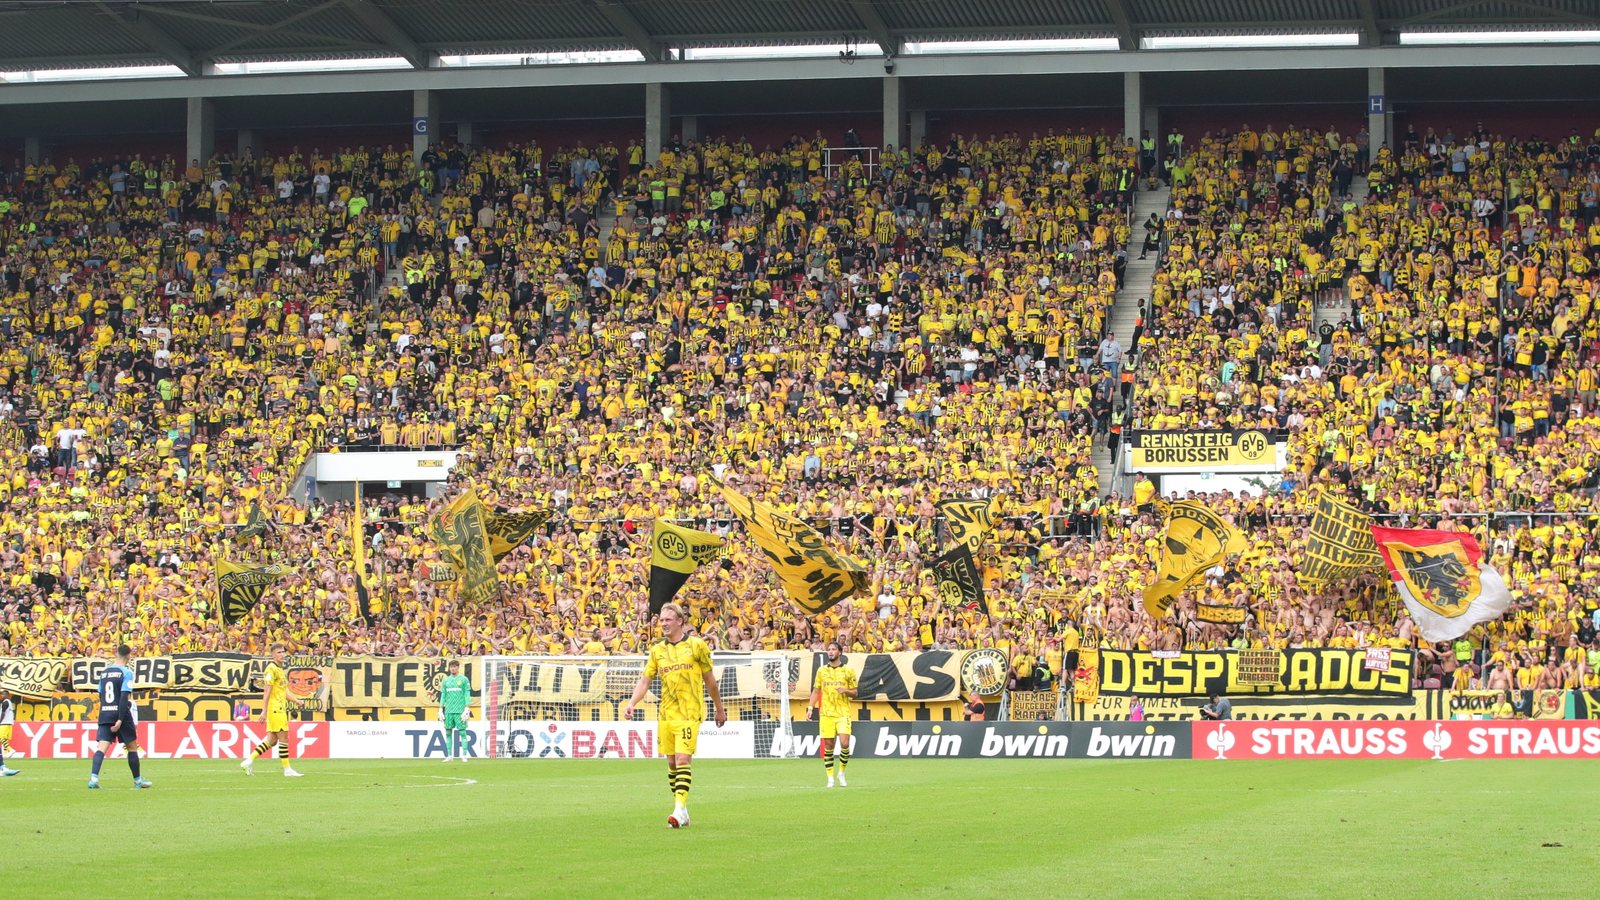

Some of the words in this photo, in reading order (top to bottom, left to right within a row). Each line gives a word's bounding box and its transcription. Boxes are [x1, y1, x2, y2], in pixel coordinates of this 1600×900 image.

[1371, 98, 1383, 111] H
[415, 119, 427, 132] G
[1140, 432, 1233, 447] RENNSTEIG
[1242, 434, 1264, 452] BVB
[1145, 447, 1229, 463] BORUSSEN
[662, 535, 684, 553] BVB
[19, 682, 42, 693] 2008
[336, 662, 419, 697] THE
[105, 681, 115, 704] 8
[1014, 692, 1056, 701] NIEMALS
[1014, 702, 1056, 710] AUFGEBEN
[681, 726, 692, 740] 19
[874, 725, 962, 756] bwin
[980, 725, 1069, 757] bwin
[1086, 725, 1176, 757] bwin
[1251, 727, 1408, 755] STRAUSS
[571, 729, 664, 758] BAN
